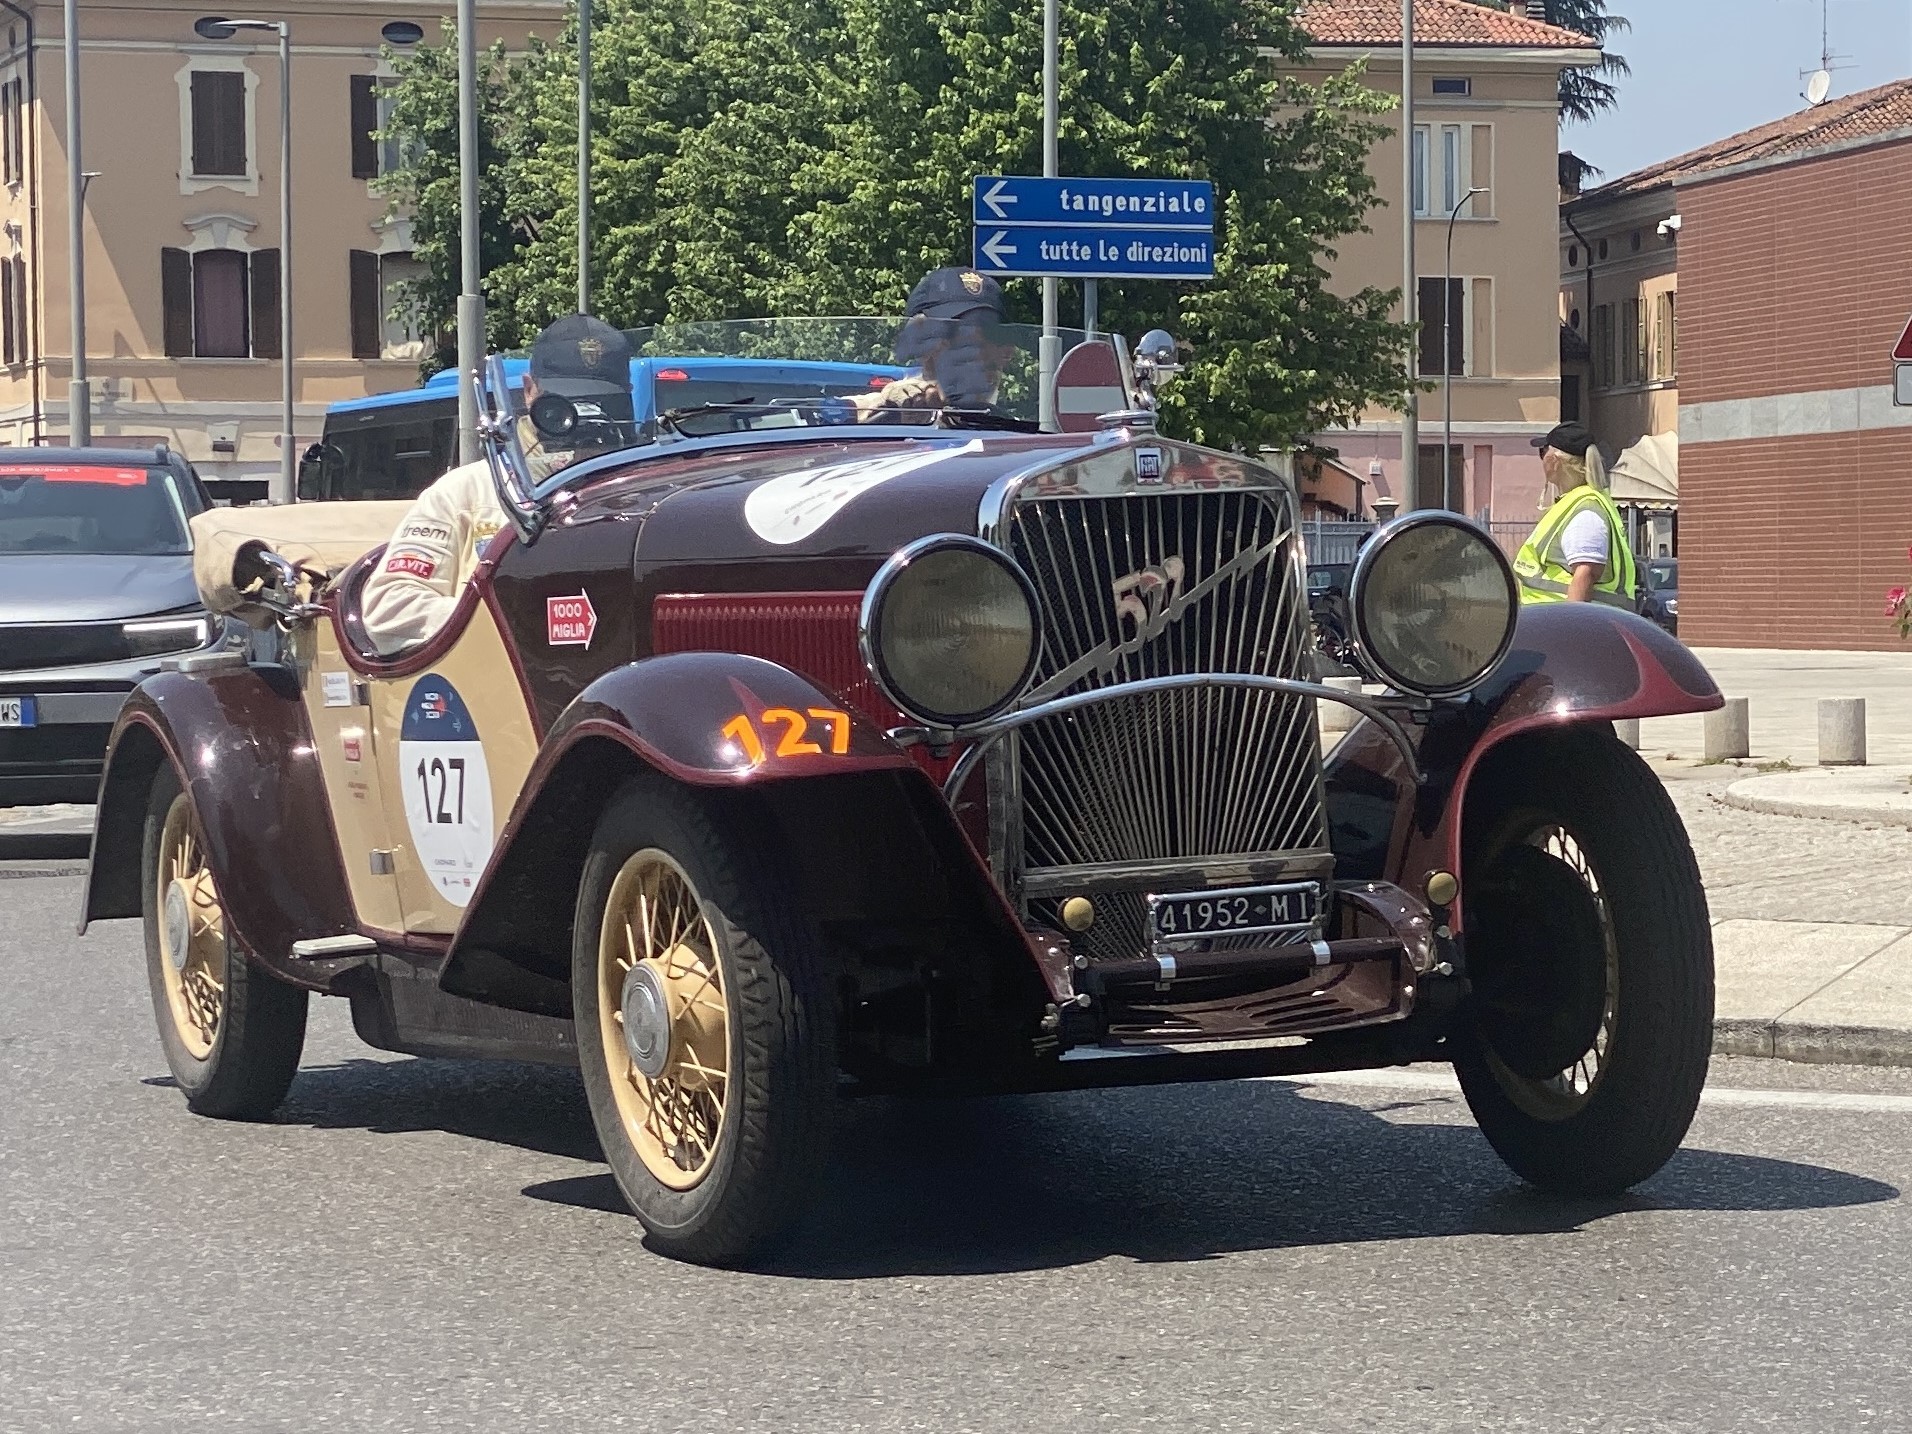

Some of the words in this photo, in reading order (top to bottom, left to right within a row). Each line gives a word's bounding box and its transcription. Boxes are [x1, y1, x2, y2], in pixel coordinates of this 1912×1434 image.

[1060, 188, 1206, 216] tangenziale
[1040, 240, 1092, 261] tutte
[1099, 239, 1119, 261] le
[1126, 241, 1207, 263] direzioni
[553, 602, 583, 619] 1000
[552, 622, 586, 638] MIGLIA
[722, 708, 851, 762] 127
[417, 757, 465, 825] 127
[1160, 897, 1249, 932] 41952
